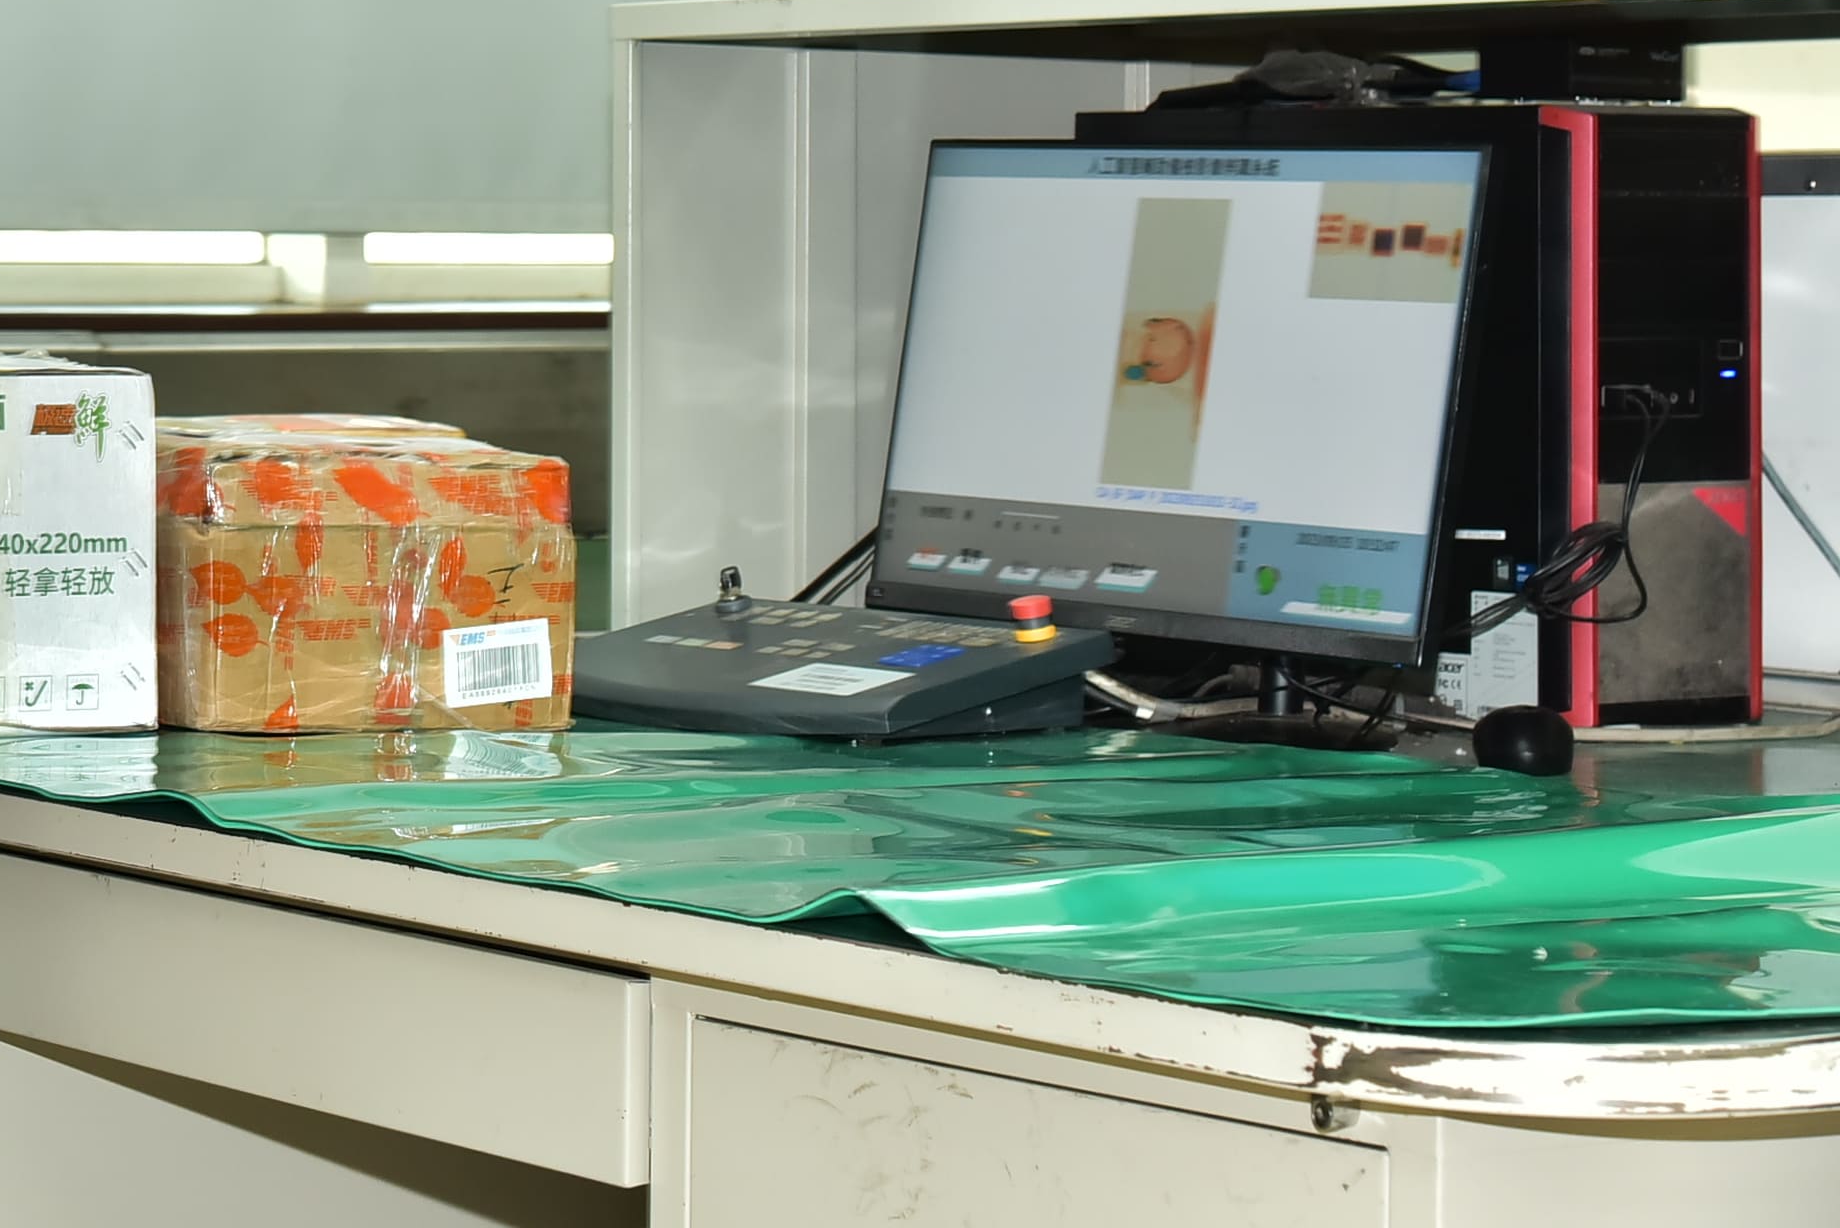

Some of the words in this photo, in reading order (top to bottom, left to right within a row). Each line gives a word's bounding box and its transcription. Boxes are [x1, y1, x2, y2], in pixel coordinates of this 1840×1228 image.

[4, 566, 116, 598] 轻拿轻放
[460, 631, 486, 646] EMS
[1438, 661, 1464, 674] acer
